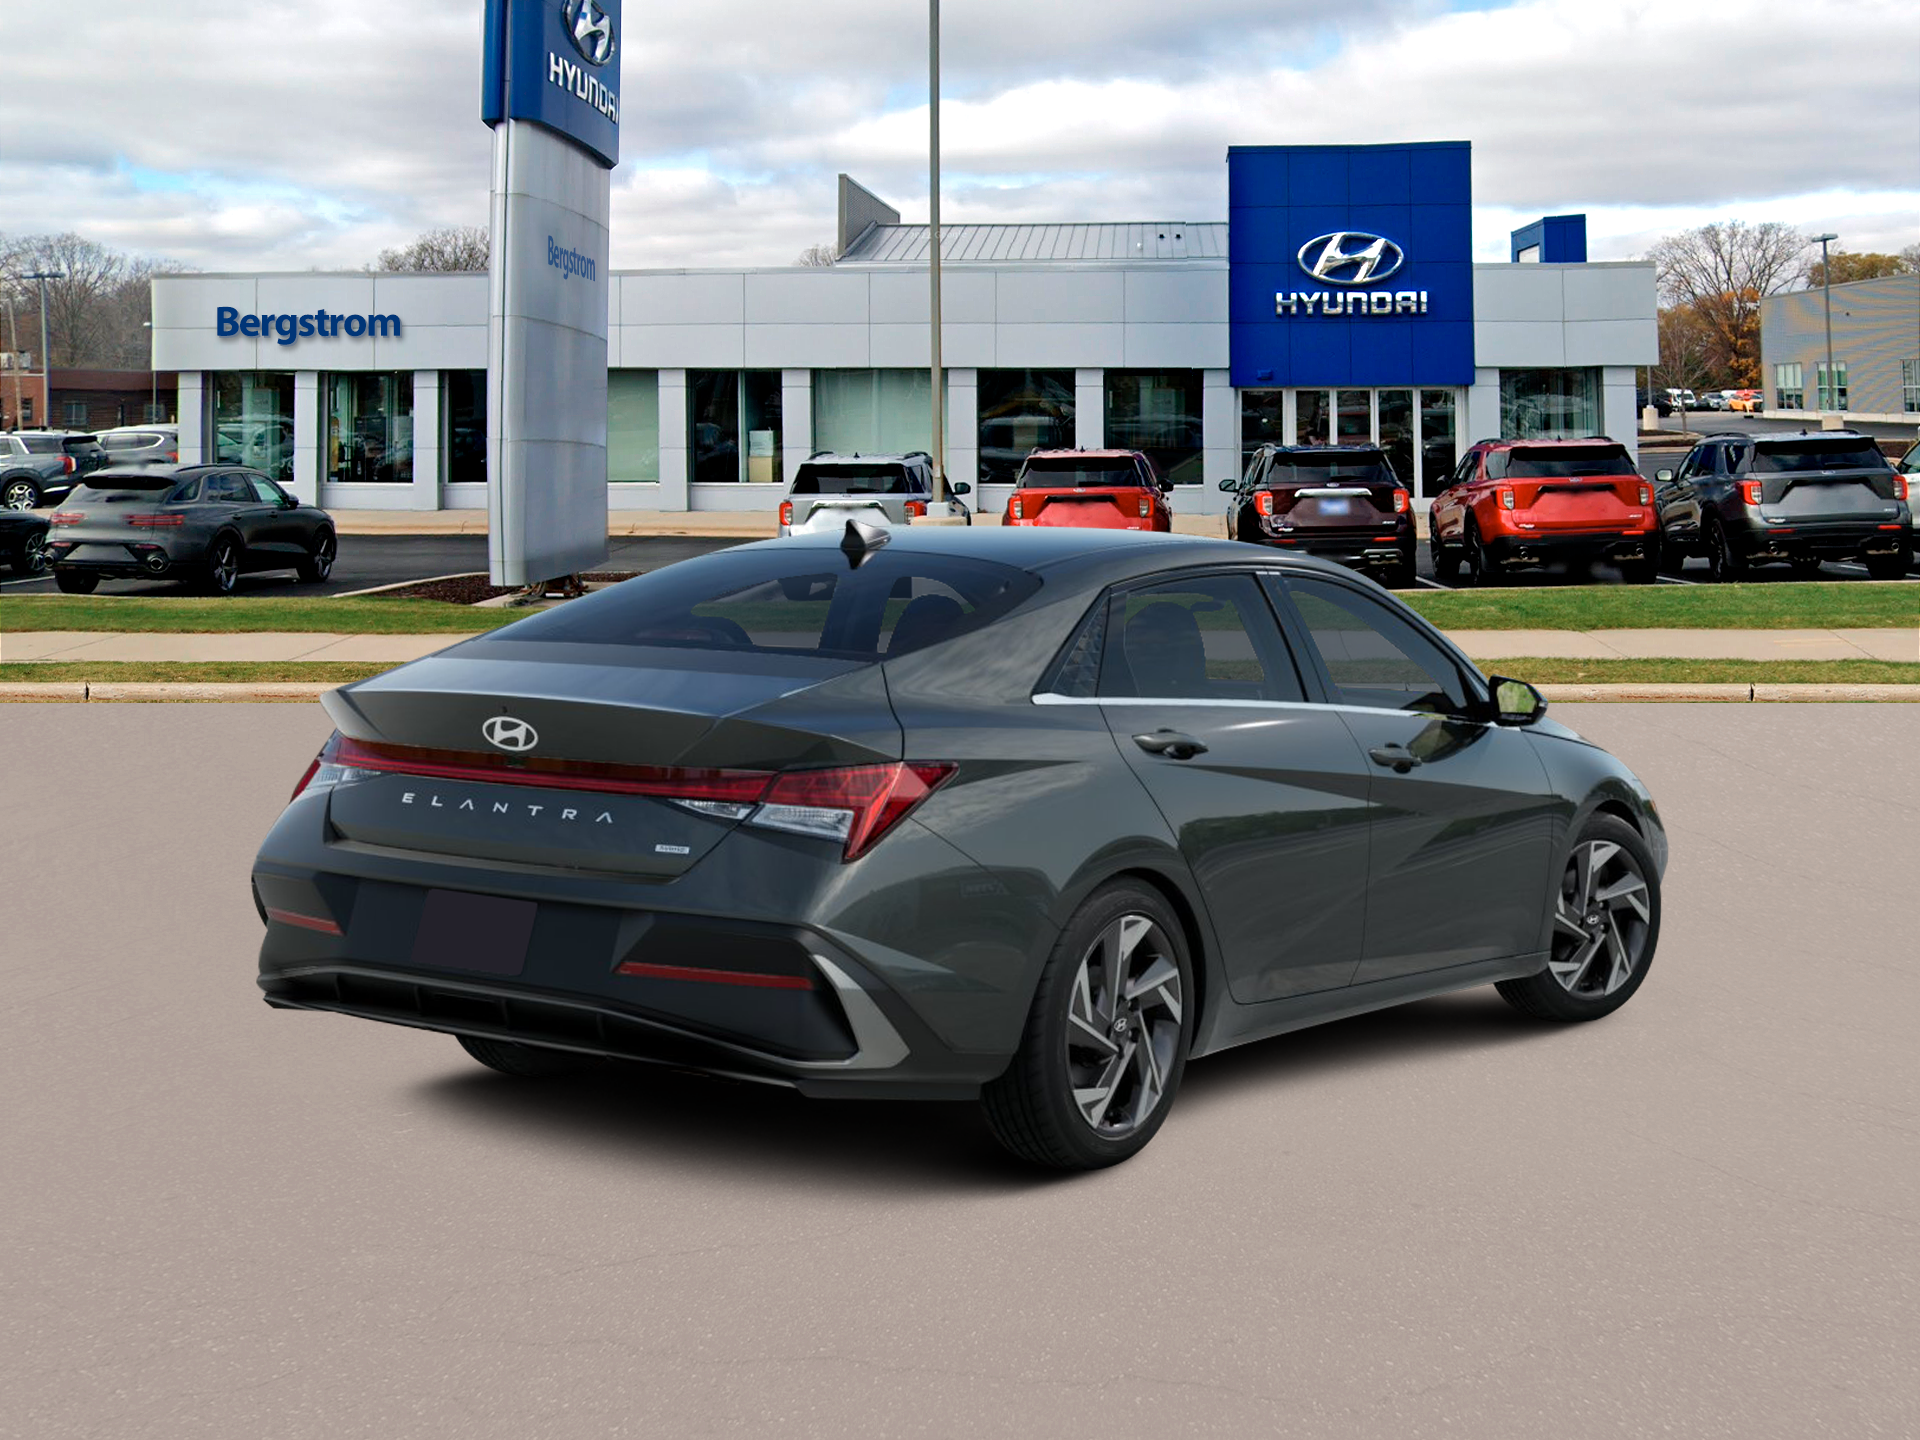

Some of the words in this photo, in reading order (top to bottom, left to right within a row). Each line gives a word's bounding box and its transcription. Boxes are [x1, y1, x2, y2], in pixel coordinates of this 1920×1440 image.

[549, 52, 619, 123] HYUNDAI
[548, 235, 595, 281] Bergstrom
[1276, 291, 1428, 315] HYUNDAI
[217, 306, 402, 346] Bergstrom
[401, 792, 614, 824] ELANTRA
